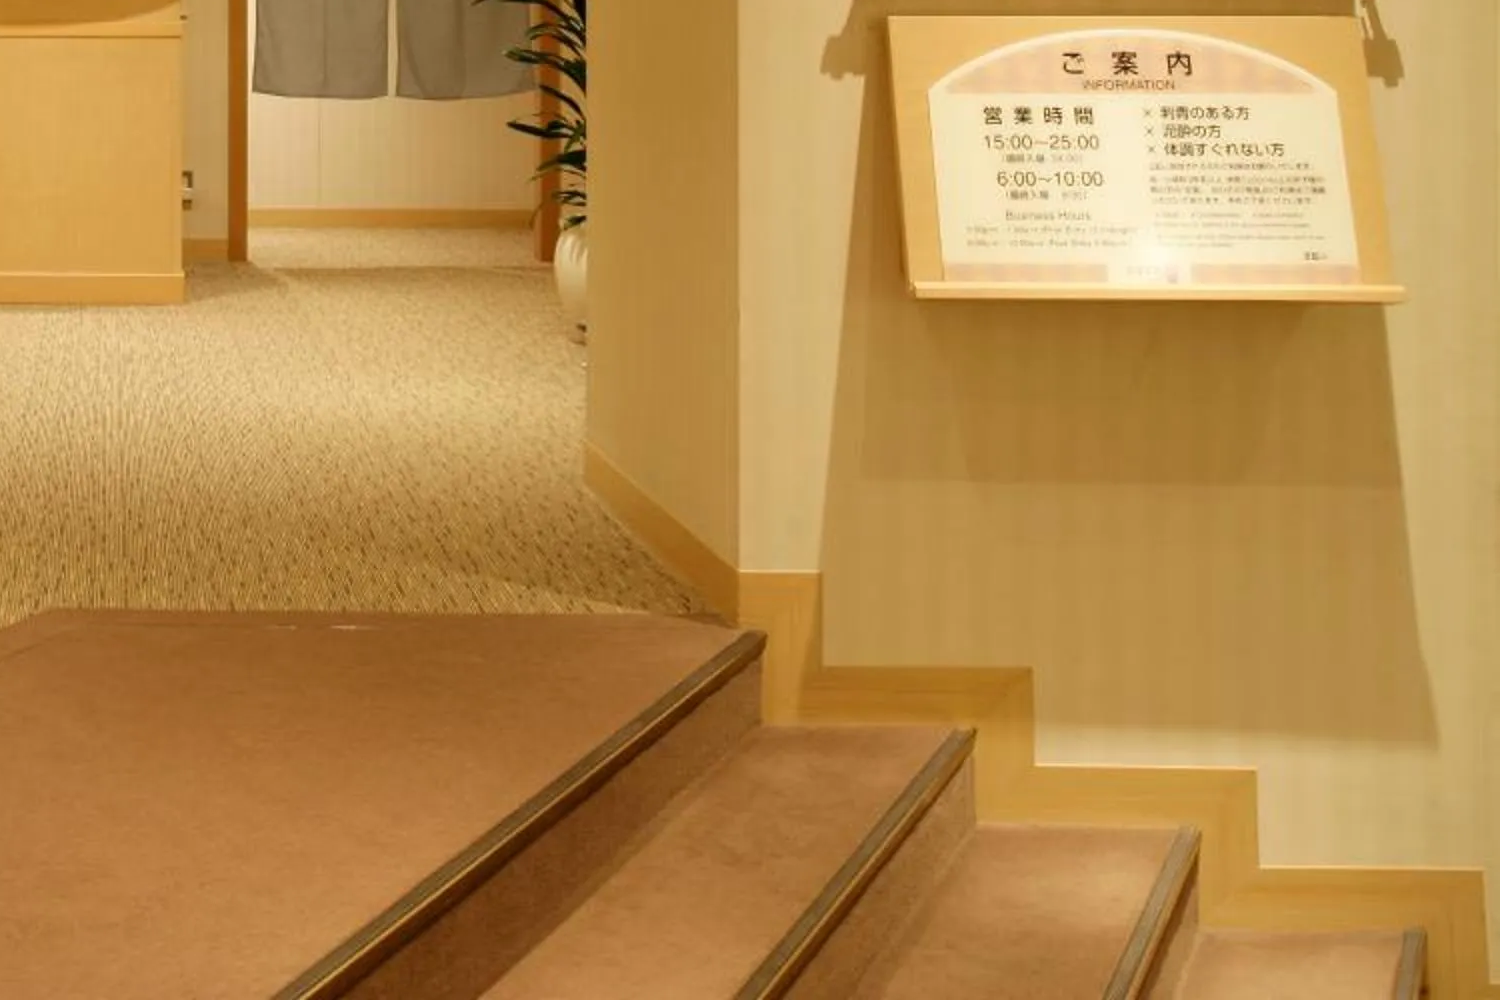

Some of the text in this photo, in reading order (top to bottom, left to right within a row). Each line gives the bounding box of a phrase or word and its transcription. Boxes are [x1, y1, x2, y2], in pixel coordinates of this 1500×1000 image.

[1061, 51, 1193, 77] ご案内
[1082, 79, 1176, 91] INFORMATION
[983, 105, 1095, 126] 営業時間
